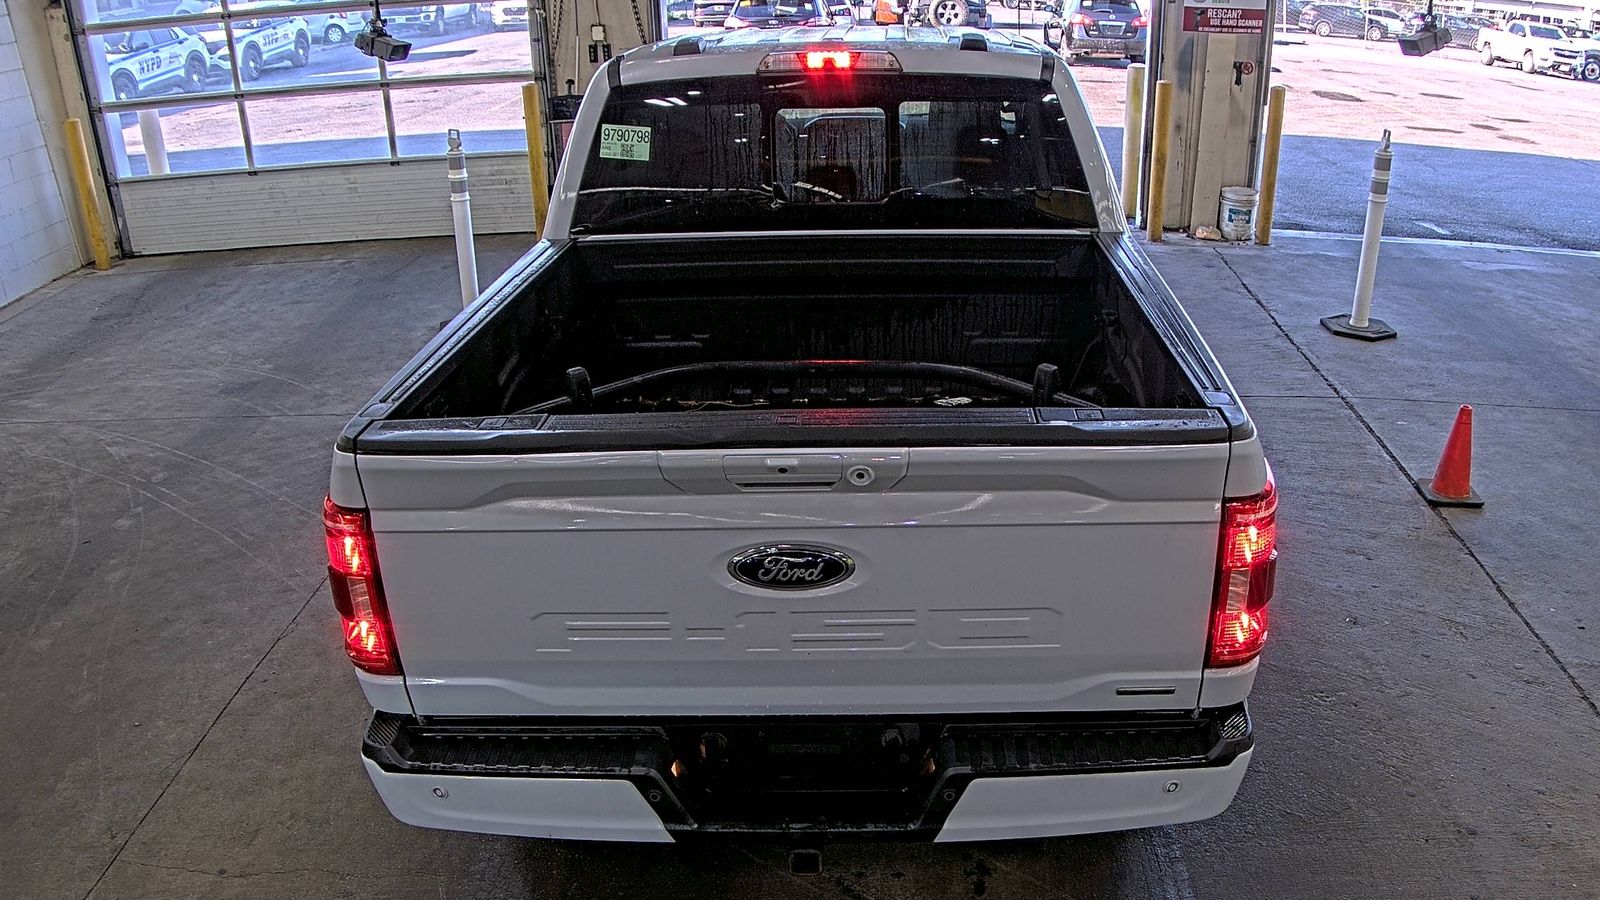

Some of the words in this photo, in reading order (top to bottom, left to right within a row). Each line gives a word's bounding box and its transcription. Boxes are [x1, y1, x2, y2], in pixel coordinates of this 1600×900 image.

[1207, 8, 1242, 19] RESCAN?
[1210, 18, 1221, 26] USE
[1221, 18, 1237, 26] HAND
[1238, 19, 1263, 27] SCANNER
[138, 55, 162, 75] NYPD
[603, 127, 650, 144] 9790798
[757, 555, 824, 582] Ford
